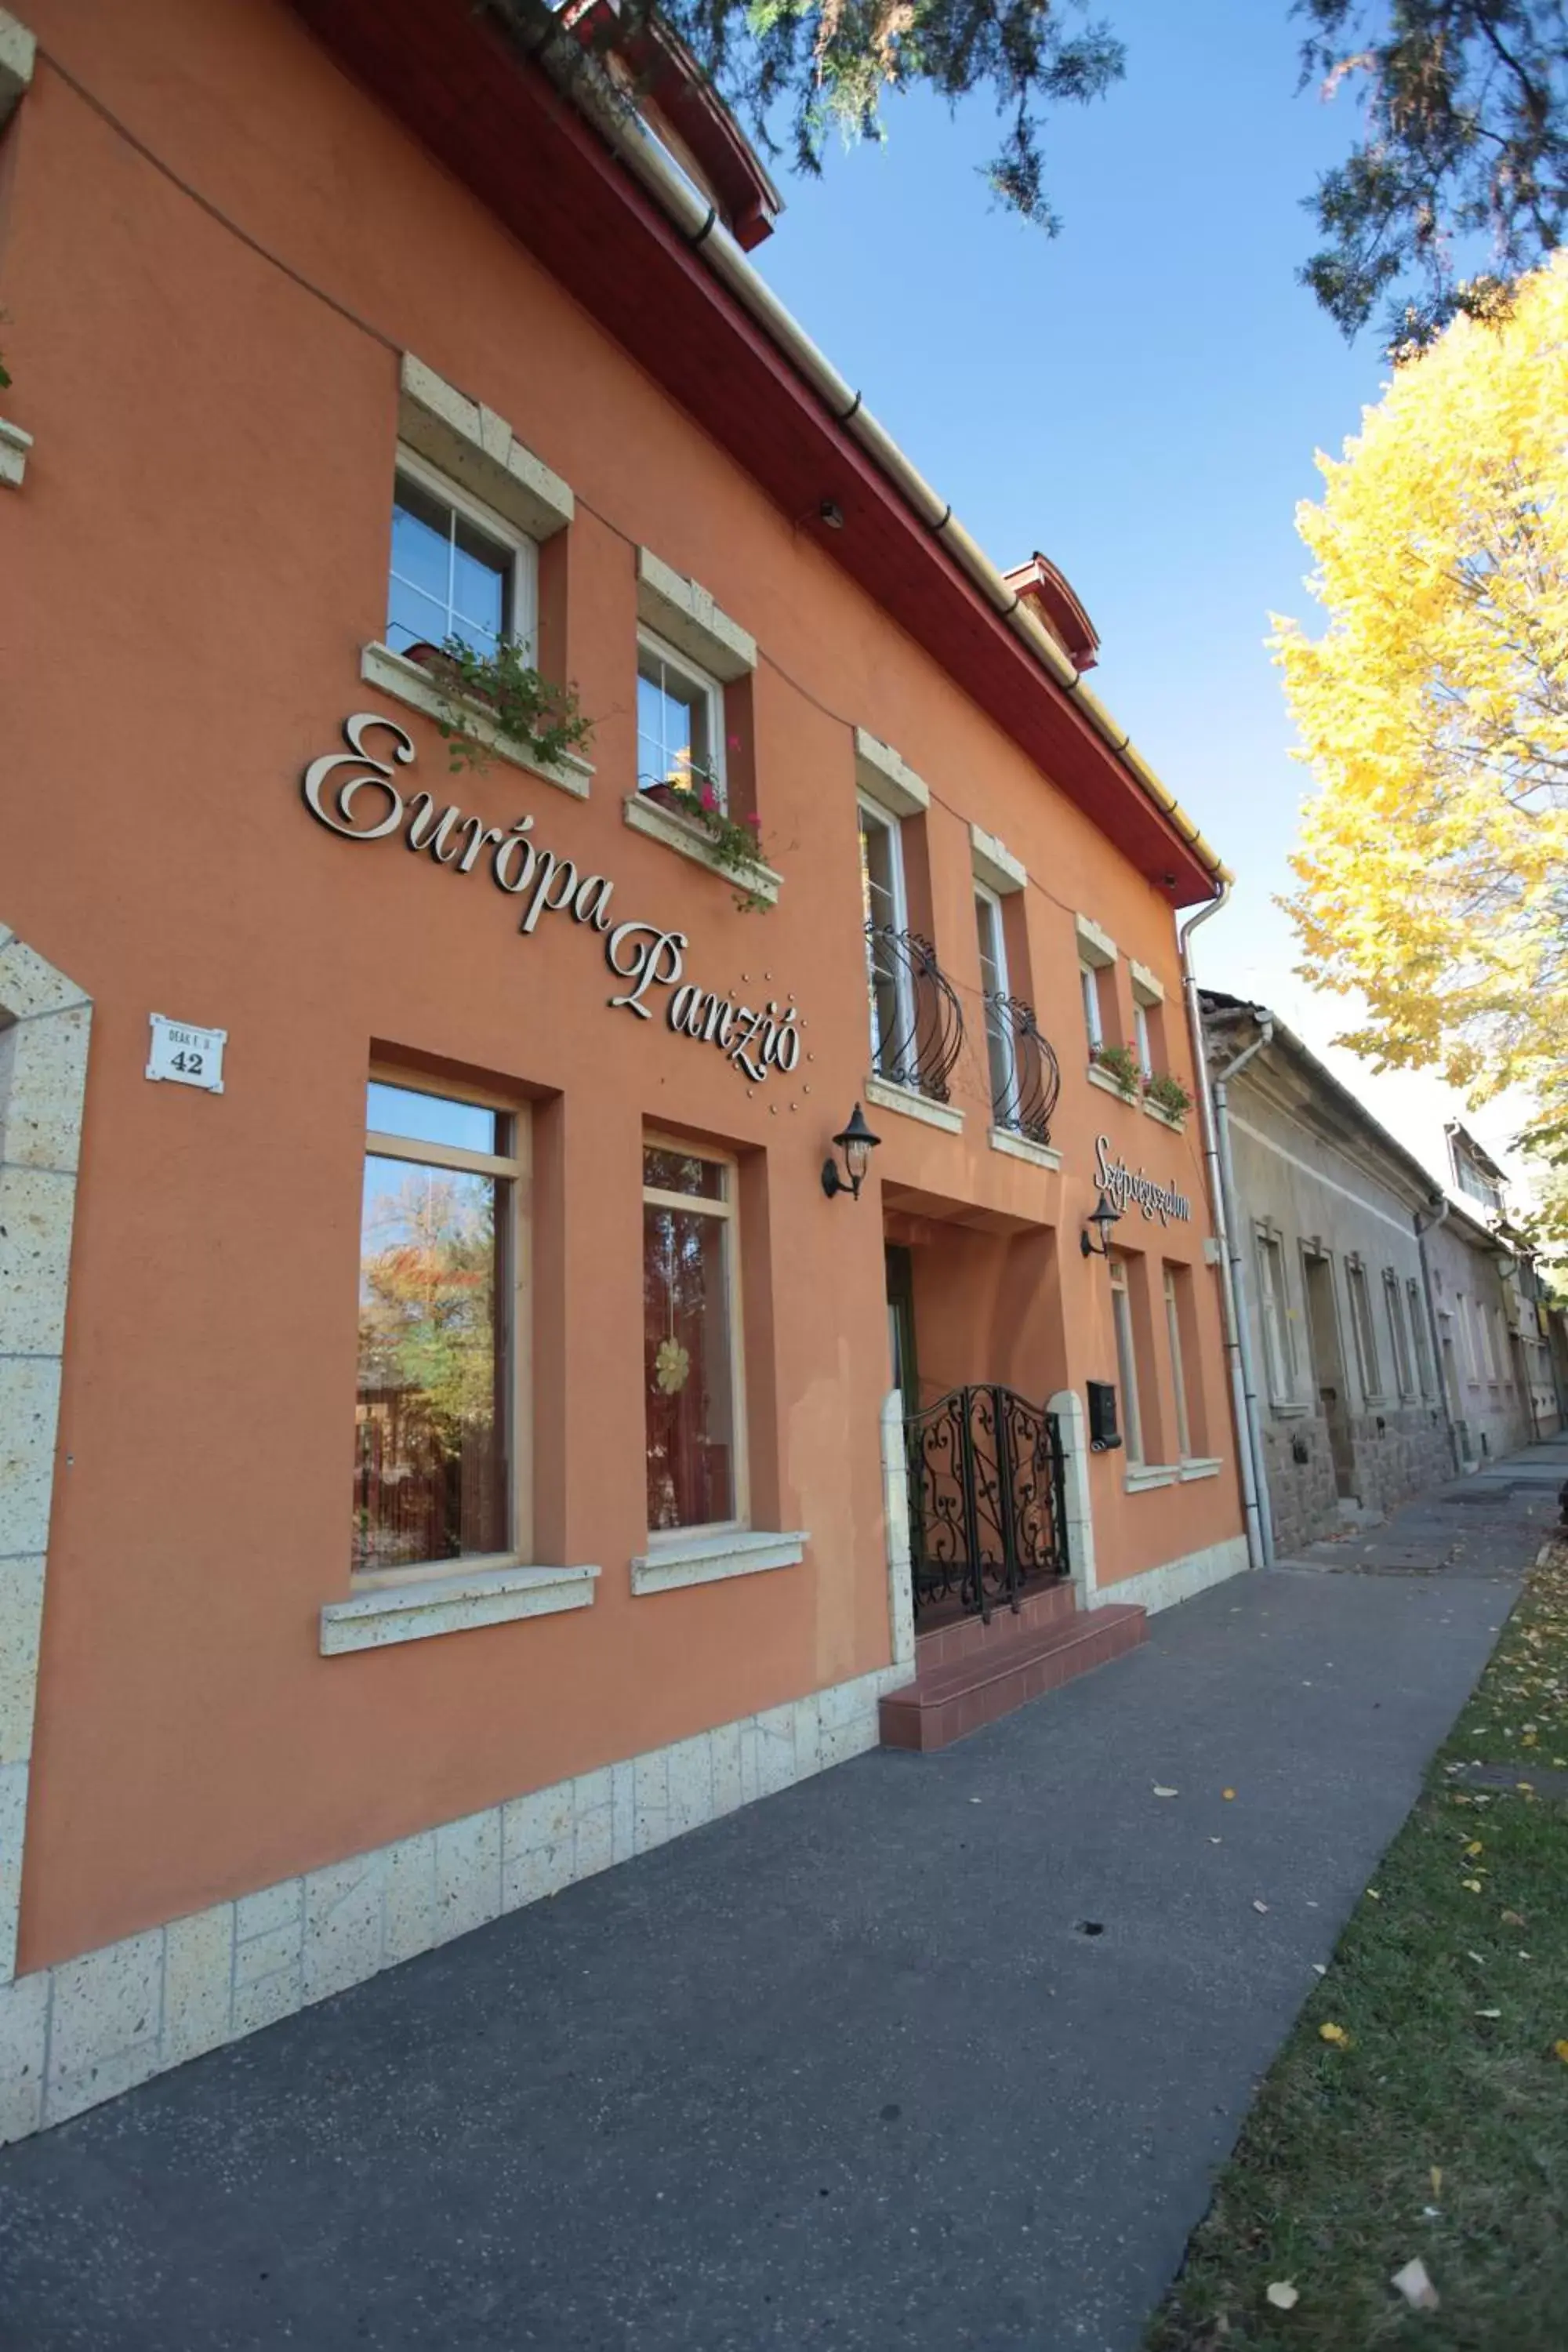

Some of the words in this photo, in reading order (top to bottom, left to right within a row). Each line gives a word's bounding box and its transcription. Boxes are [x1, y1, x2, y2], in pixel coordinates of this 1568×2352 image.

[304, 713, 614, 934] Európa
[606, 920, 801, 1083] Panzió
[170, 1051, 204, 1075] 42
